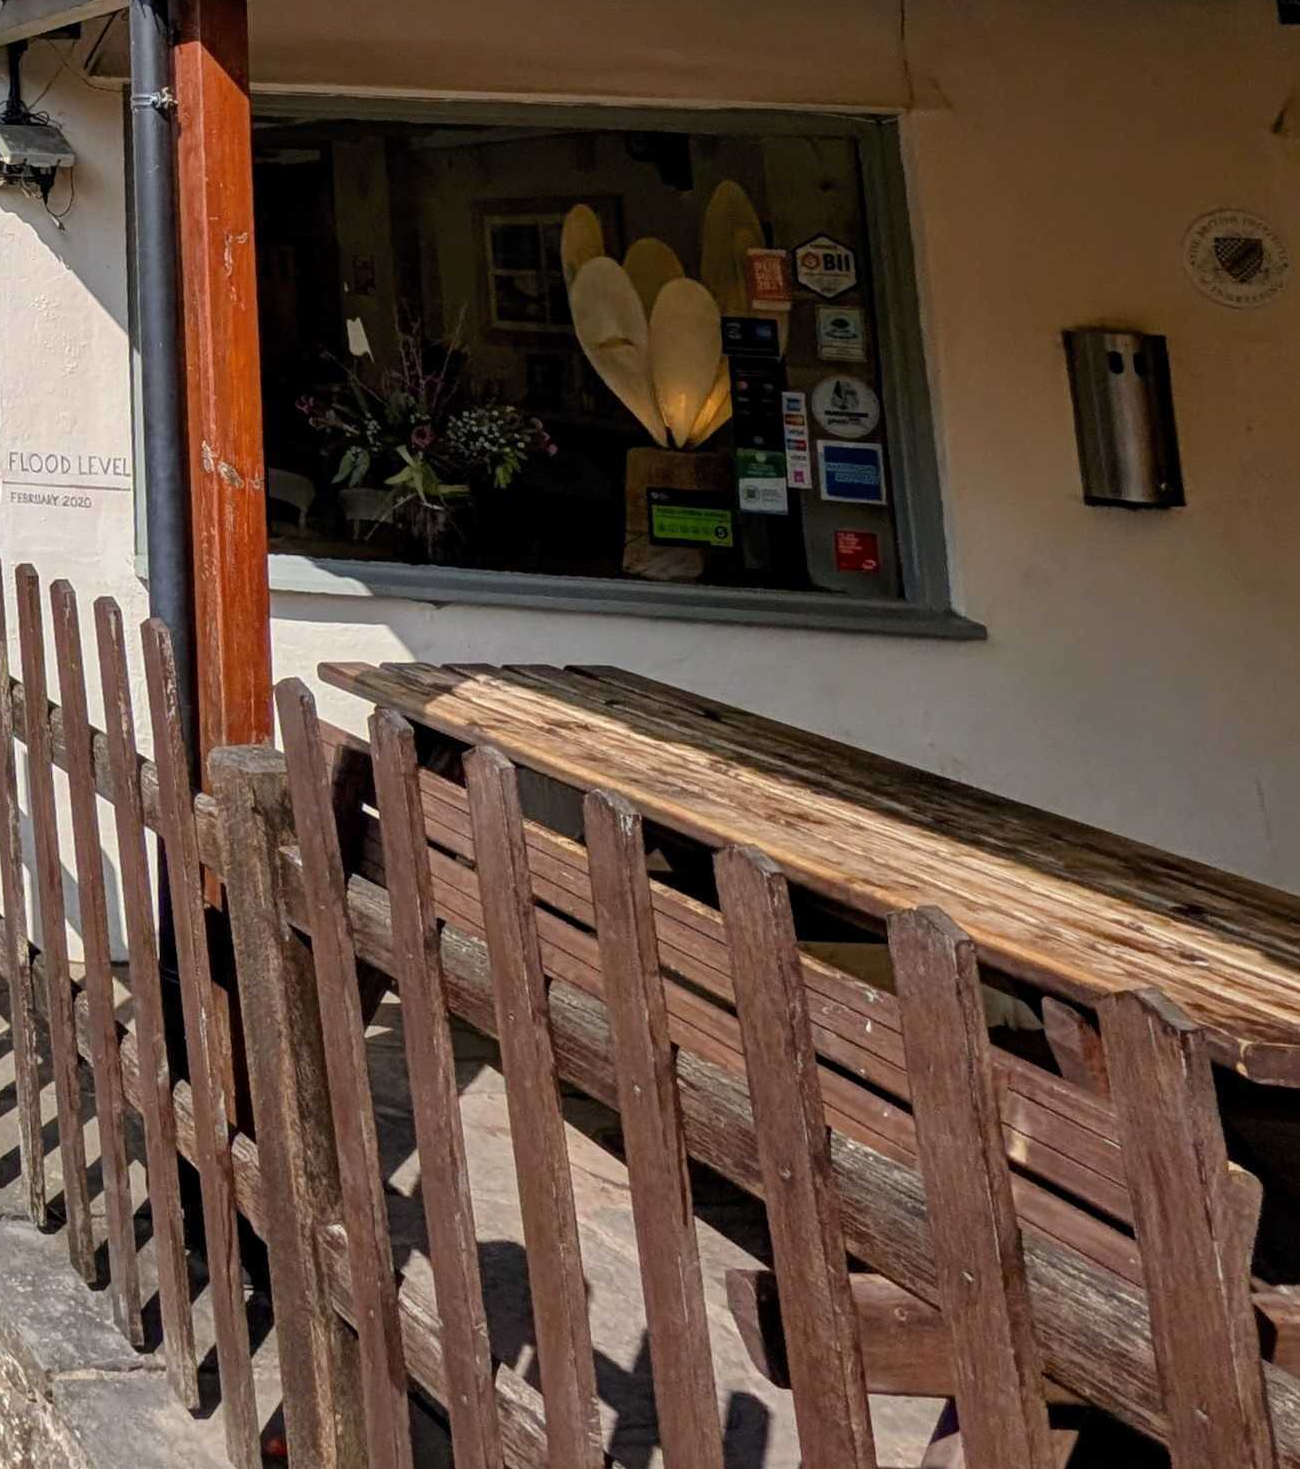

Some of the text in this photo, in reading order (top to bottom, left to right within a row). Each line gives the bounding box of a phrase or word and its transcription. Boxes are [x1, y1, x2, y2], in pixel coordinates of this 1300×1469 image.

[9, 452, 131, 477] FLOOD LEVEL
[10, 492, 92, 509] FEBRUARY 2020
